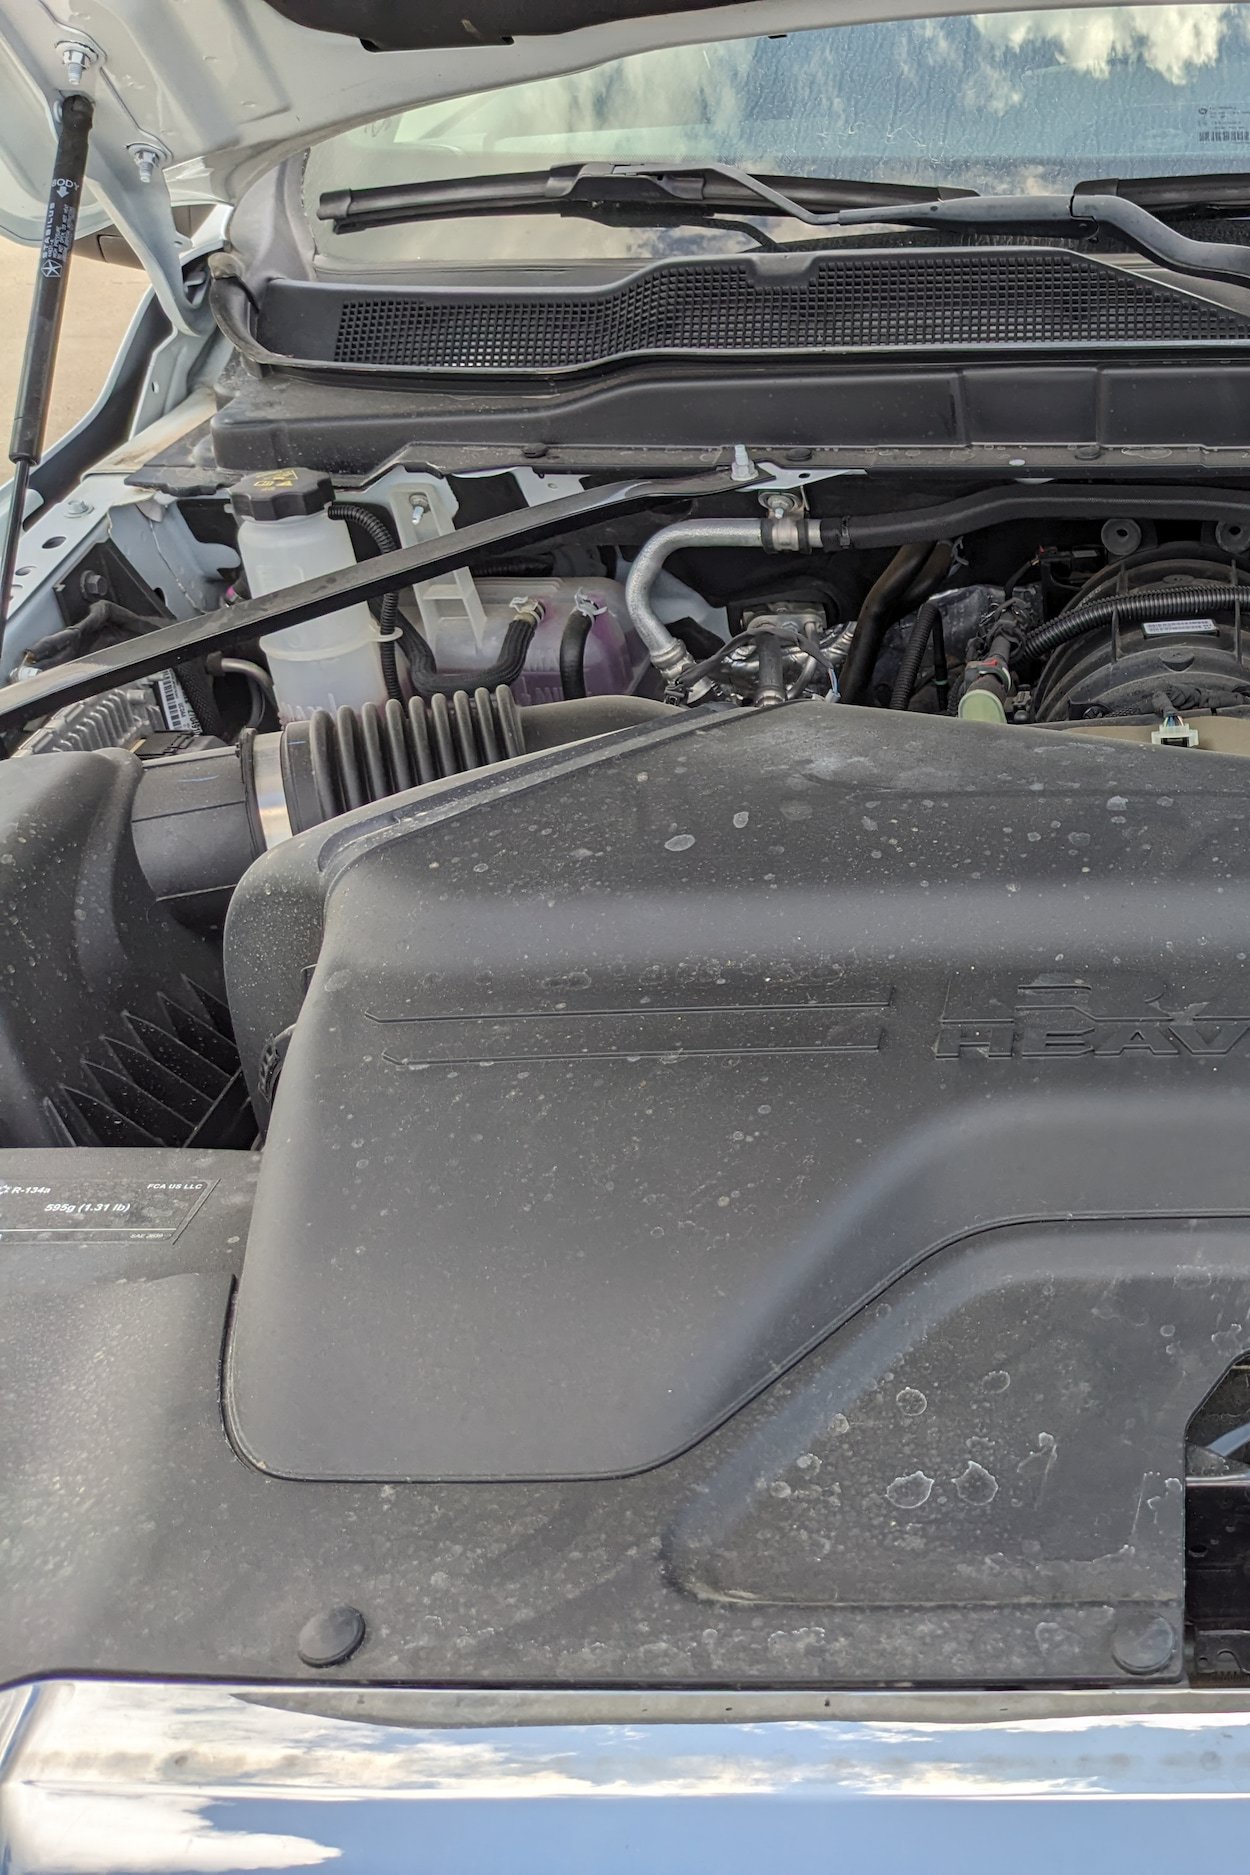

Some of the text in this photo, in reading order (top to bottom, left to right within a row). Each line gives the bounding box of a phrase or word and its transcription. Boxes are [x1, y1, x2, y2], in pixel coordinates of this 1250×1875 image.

[51, 179, 79, 190] BODY
[43, 202, 55, 258] STABILUS
[11, 1186, 51, 1194] R-134a
[44, 1203, 131, 1213] 595g (1.31 lb)
